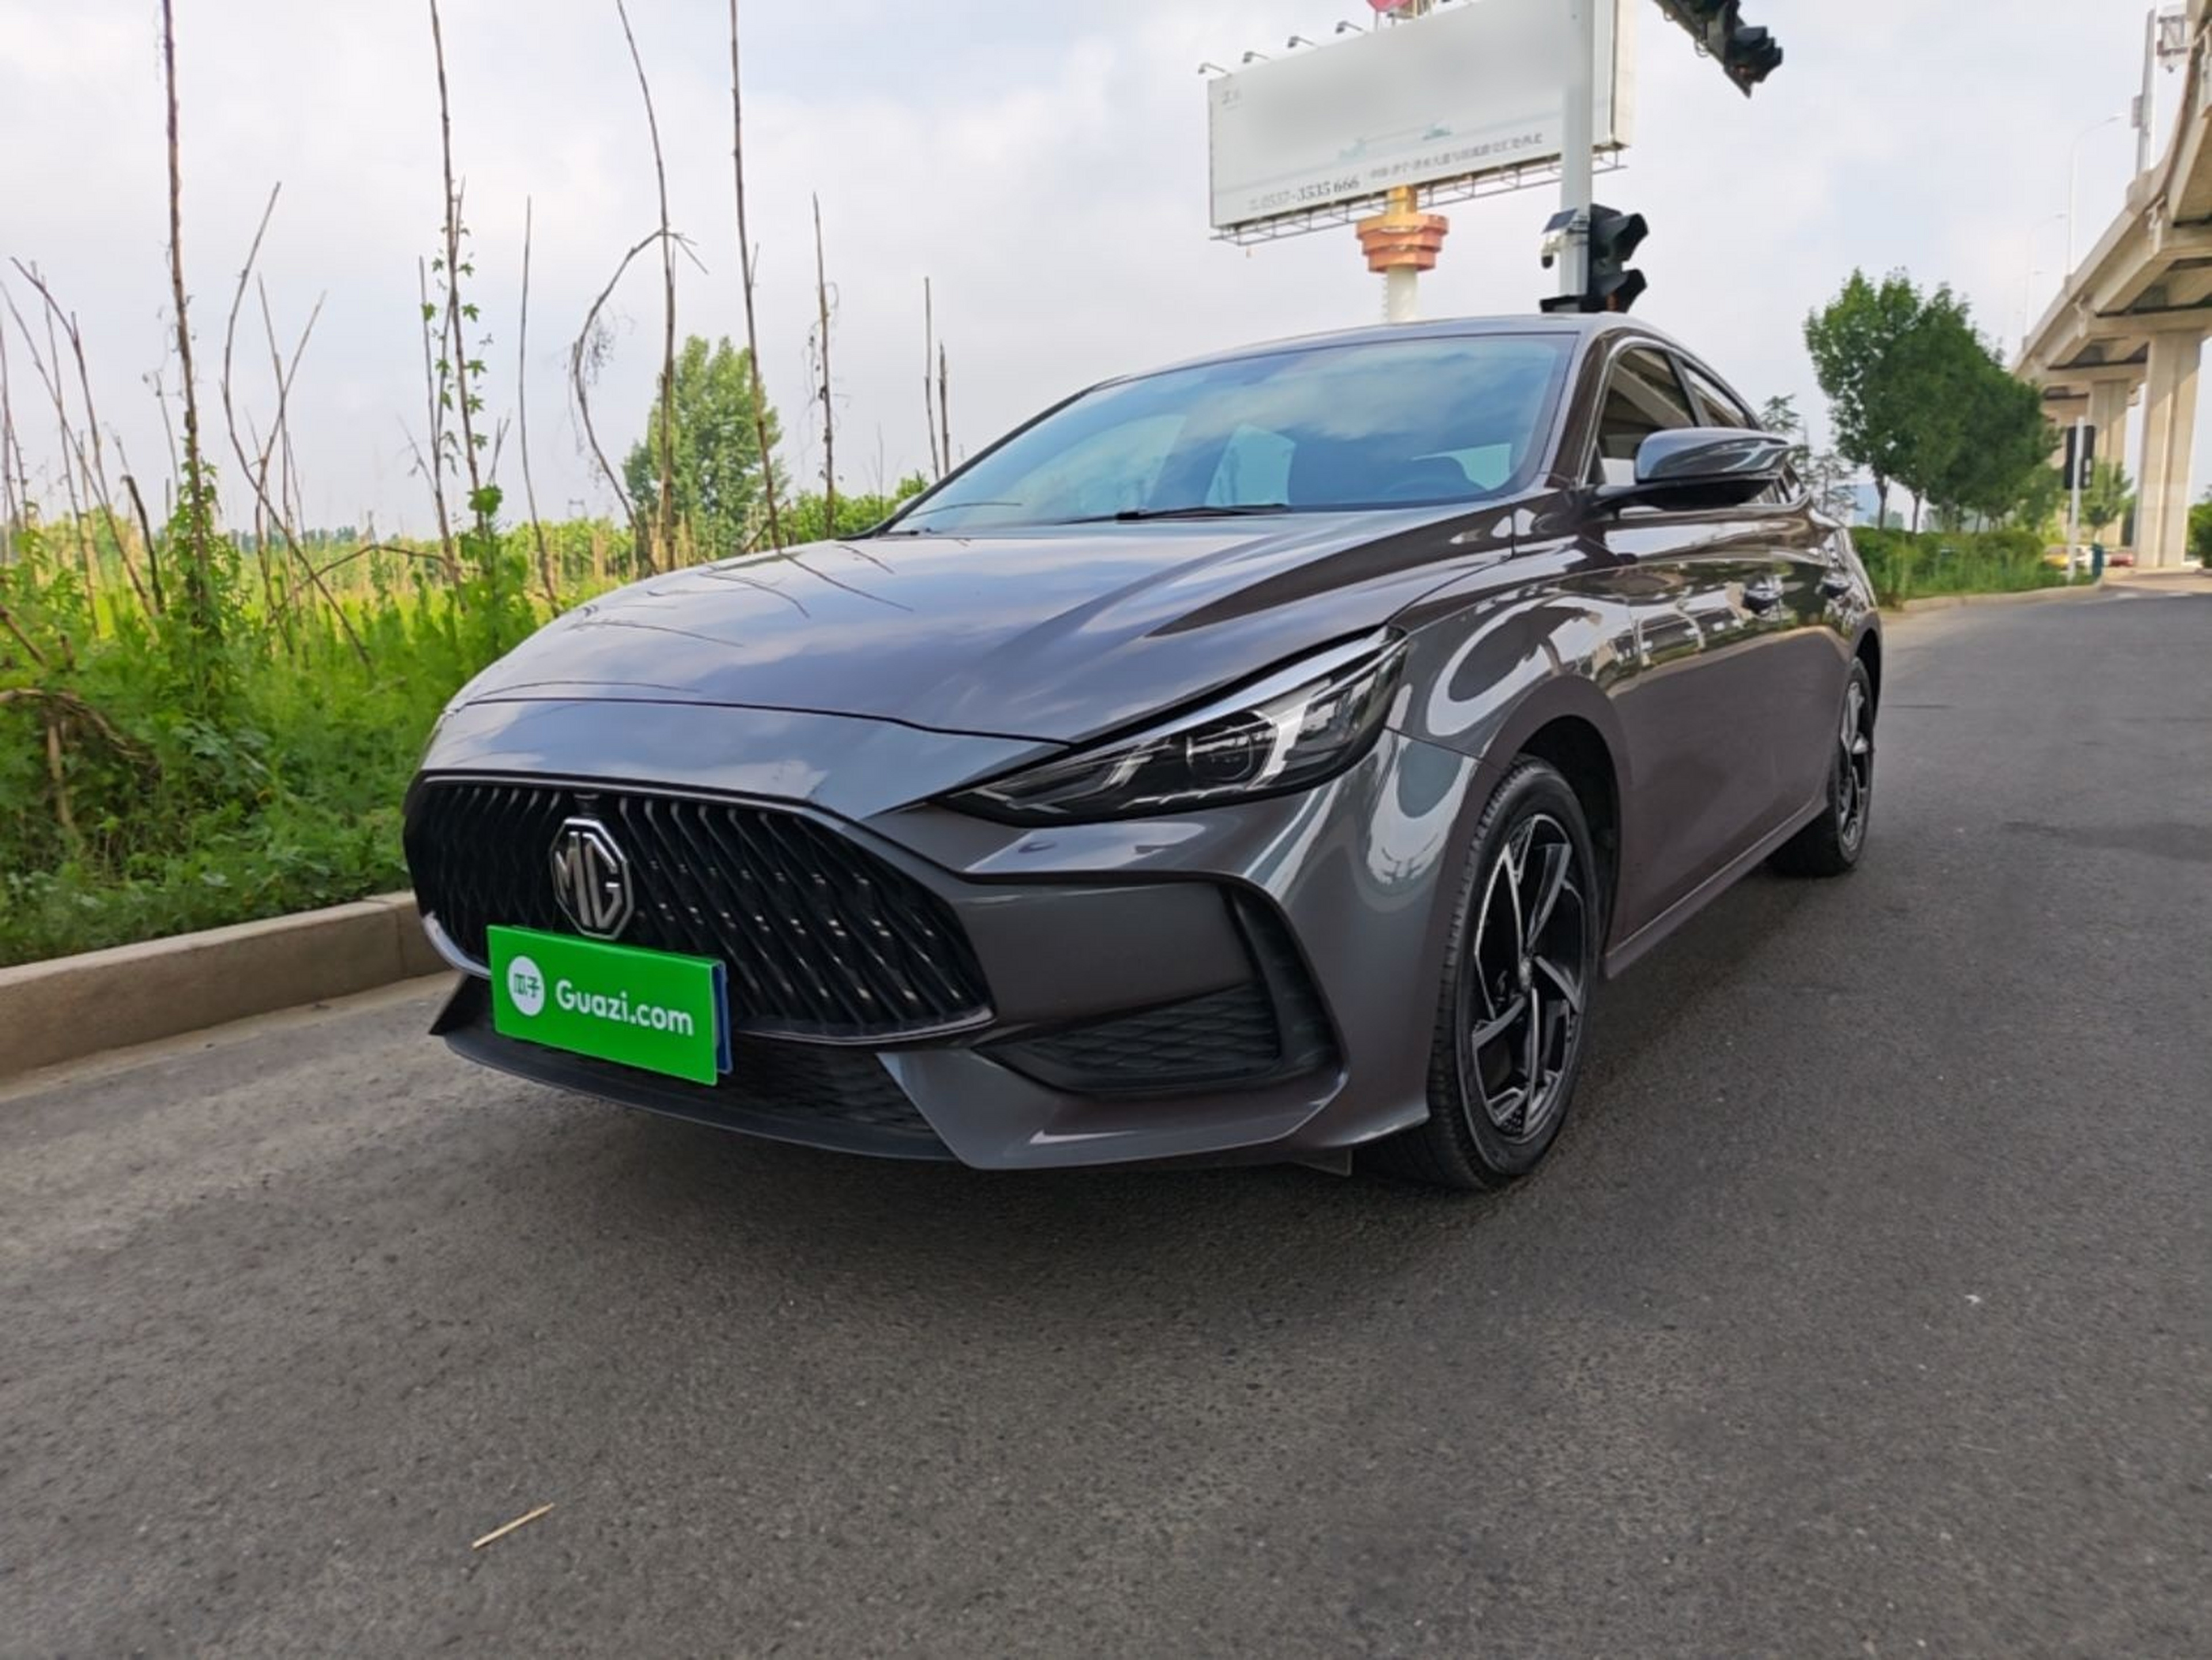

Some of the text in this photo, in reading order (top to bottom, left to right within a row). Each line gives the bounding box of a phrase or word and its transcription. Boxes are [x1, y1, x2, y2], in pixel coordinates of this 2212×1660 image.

[555, 831, 623, 929] MG
[513, 973, 540, 999] 瓜子
[556, 980, 694, 1036] Guazi.com
